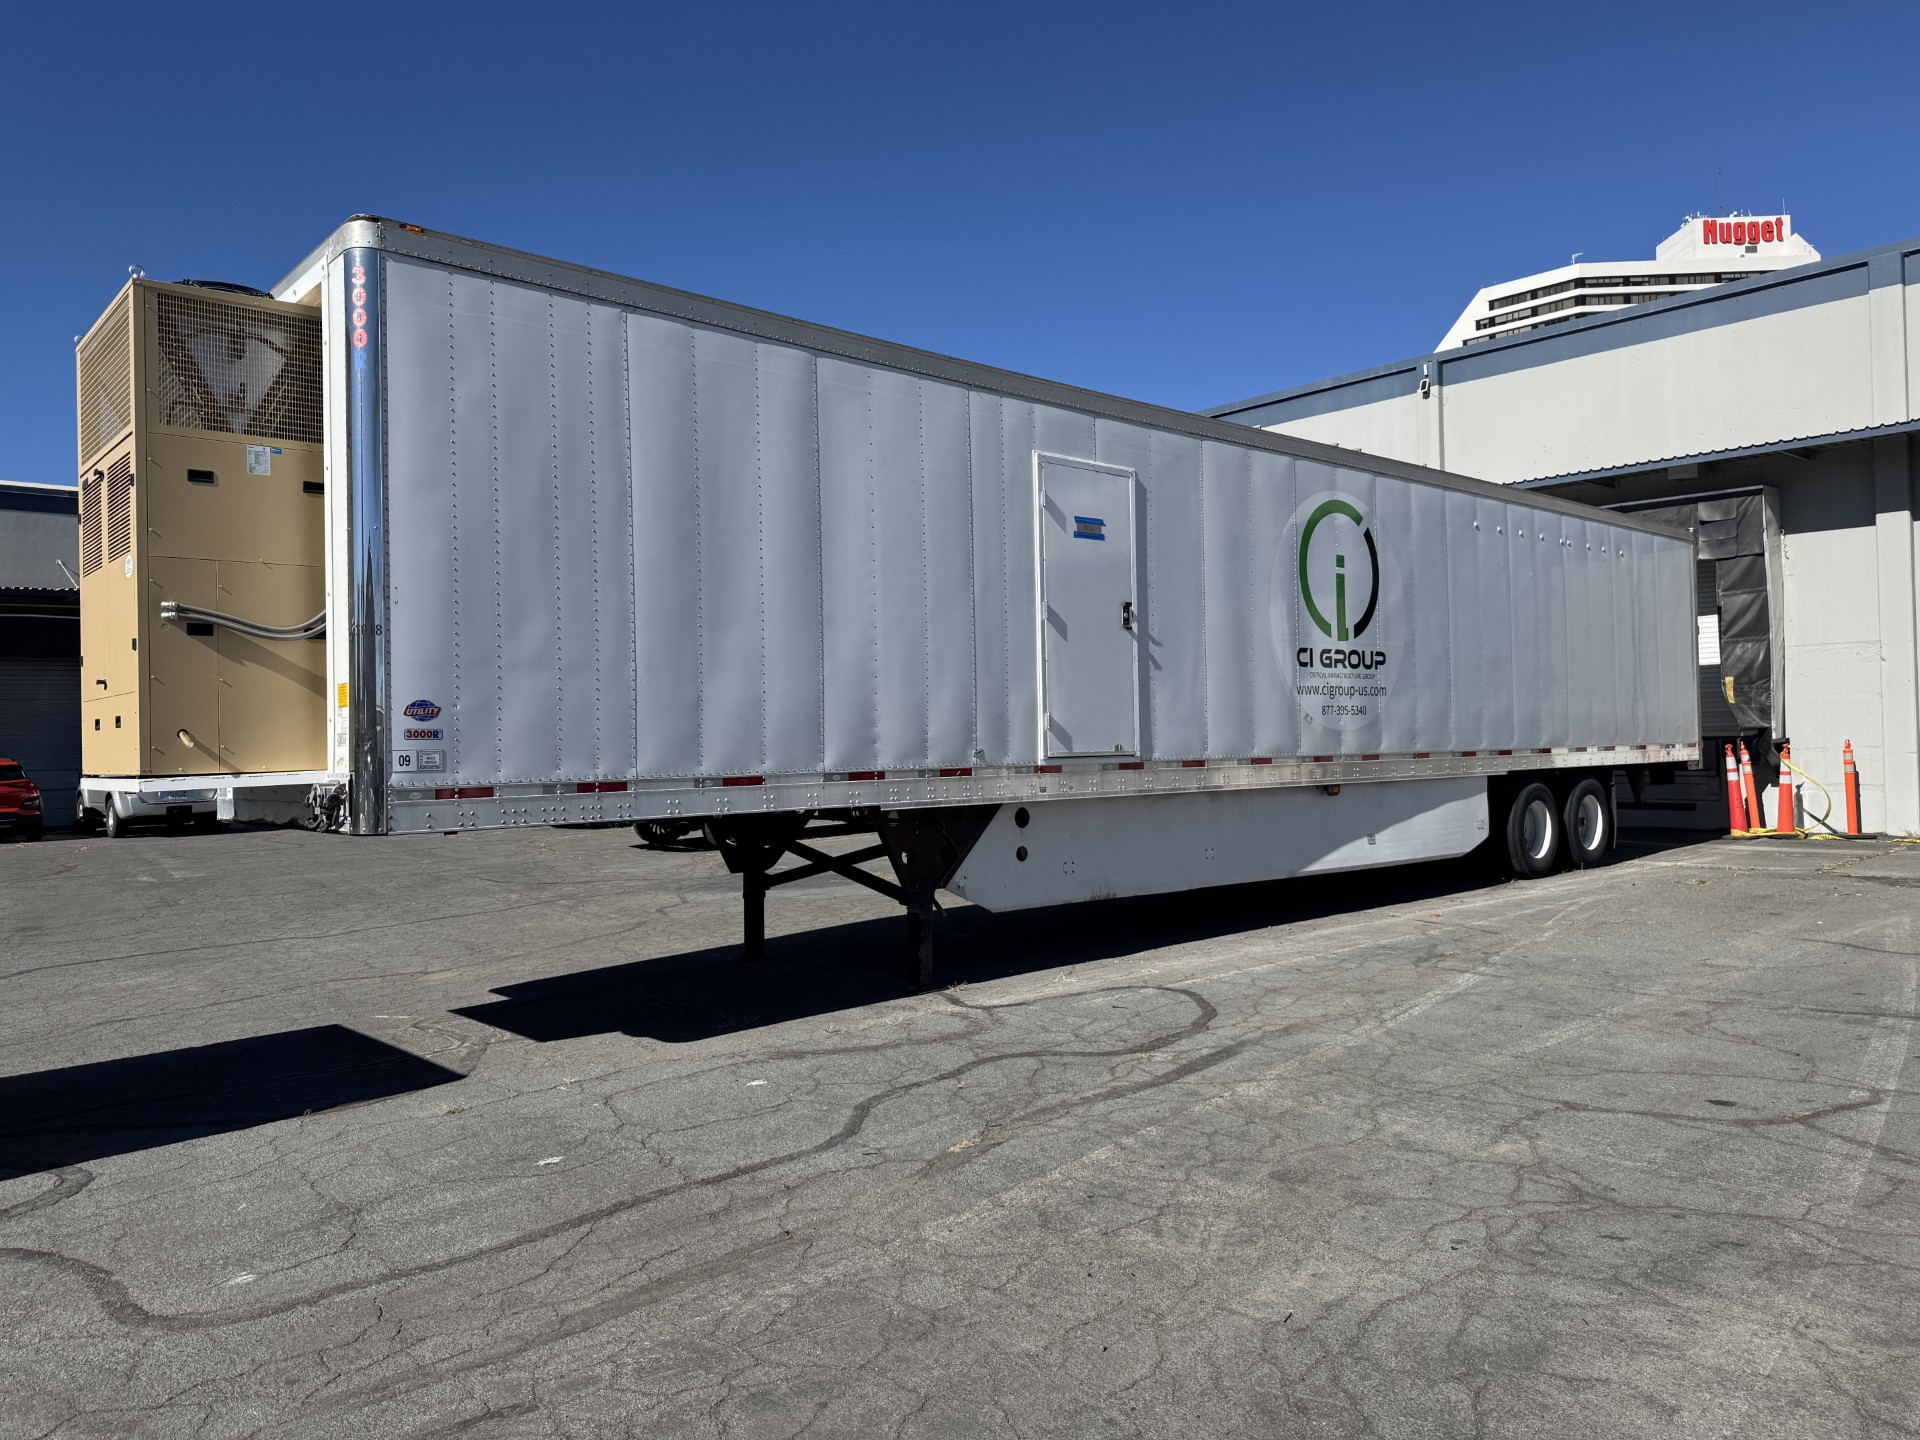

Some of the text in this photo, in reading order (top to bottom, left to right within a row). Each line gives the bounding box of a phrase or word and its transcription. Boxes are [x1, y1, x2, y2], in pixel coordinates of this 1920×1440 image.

[1703, 217, 1784, 245] Nugget
[1297, 647, 1387, 670] CI GROUP
[1309, 671, 1328, 679] CRITICAL
[1328, 672, 1362, 680] INFRASTRUCTURE
[1297, 682, 1387, 700] www.cigroup-us.com
[405, 706, 440, 716] UTILITY
[1321, 705, 1367, 716] 877-395-5340
[398, 754, 411, 767] 09
